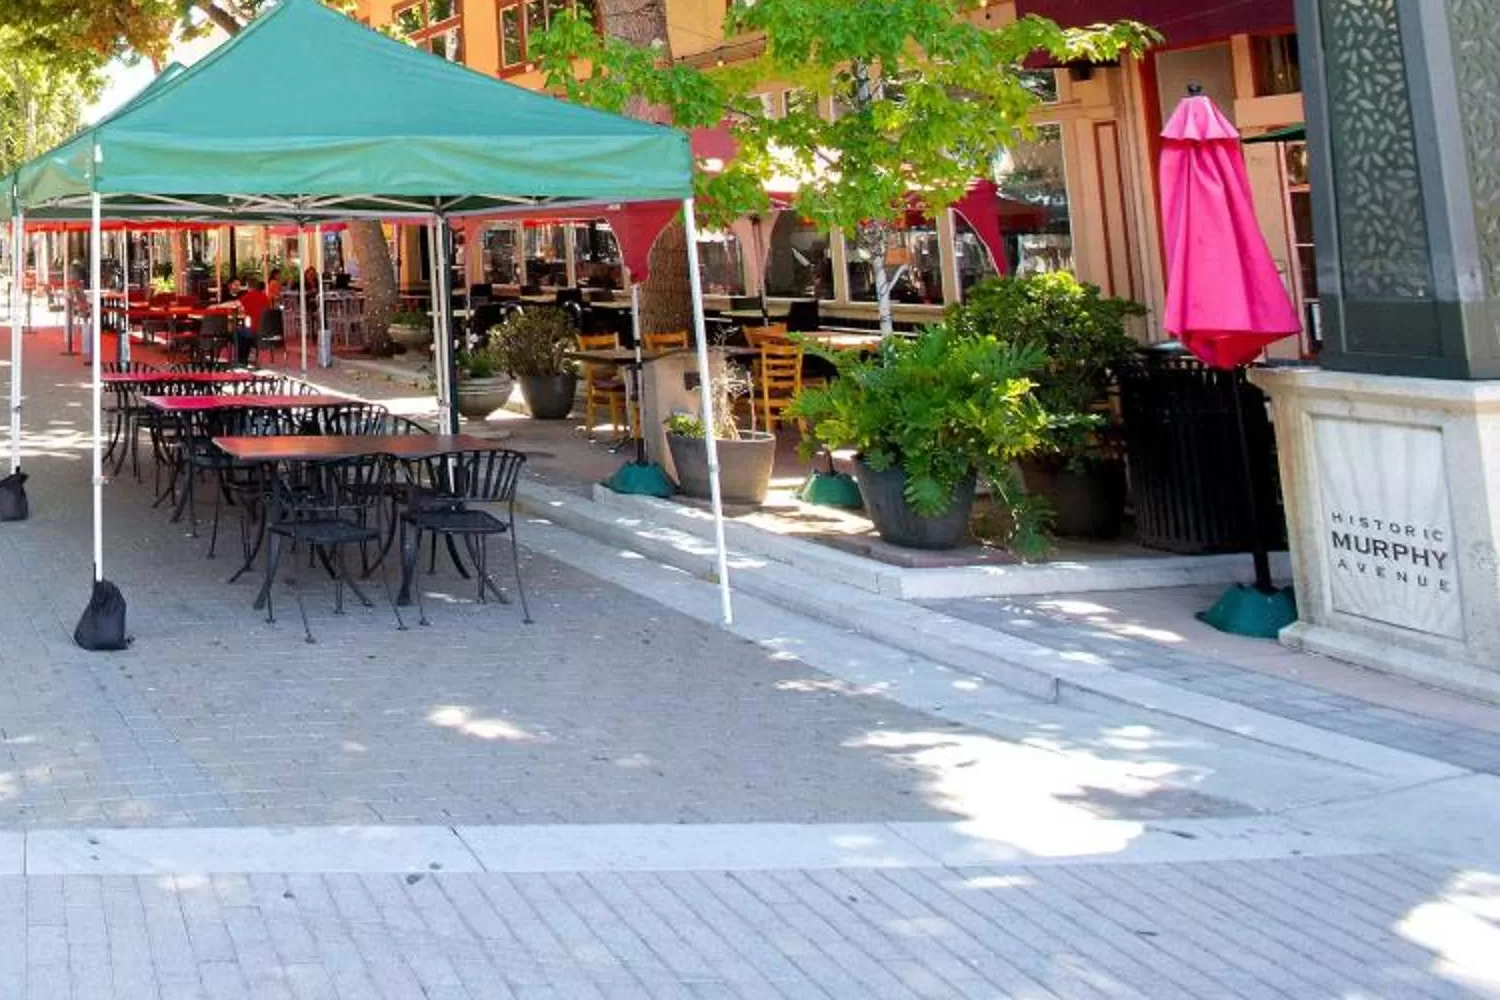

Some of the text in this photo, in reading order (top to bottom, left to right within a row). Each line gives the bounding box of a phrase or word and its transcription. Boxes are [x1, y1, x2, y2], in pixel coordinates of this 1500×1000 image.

[1331, 511, 1443, 542] HISTORIC
[1331, 530, 1448, 570] MURPHY
[1338, 558, 1451, 593] AVENUE
